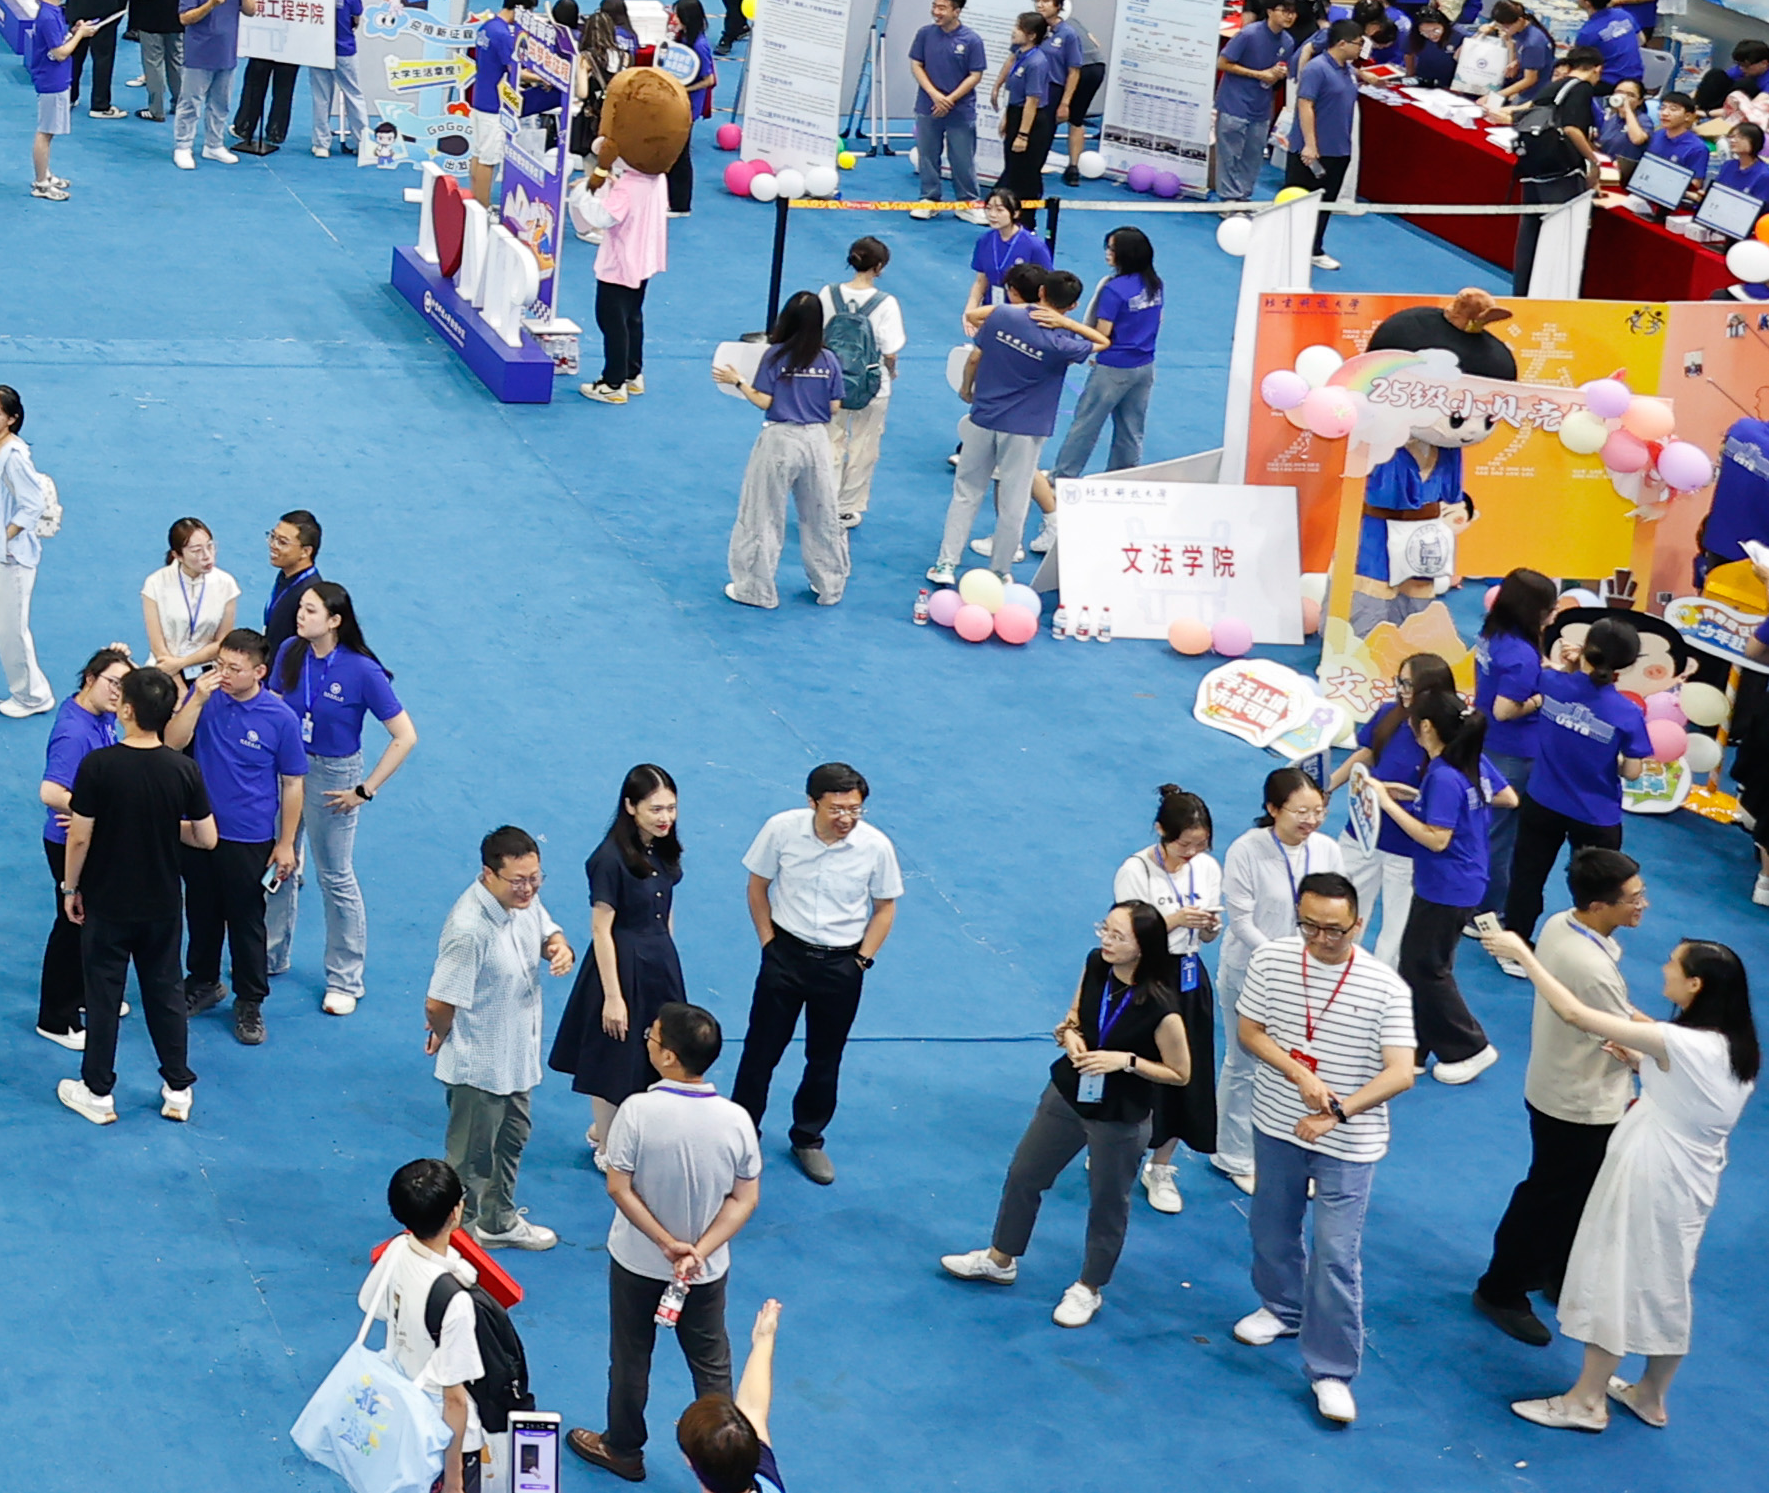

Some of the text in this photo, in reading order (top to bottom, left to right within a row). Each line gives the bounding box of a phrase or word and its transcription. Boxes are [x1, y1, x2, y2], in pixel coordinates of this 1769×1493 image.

[1264, 296, 1361, 309] 北京科技大学
[1121, 543, 1236, 578] 文法学院
[1555, 714, 1590, 737] USTB
